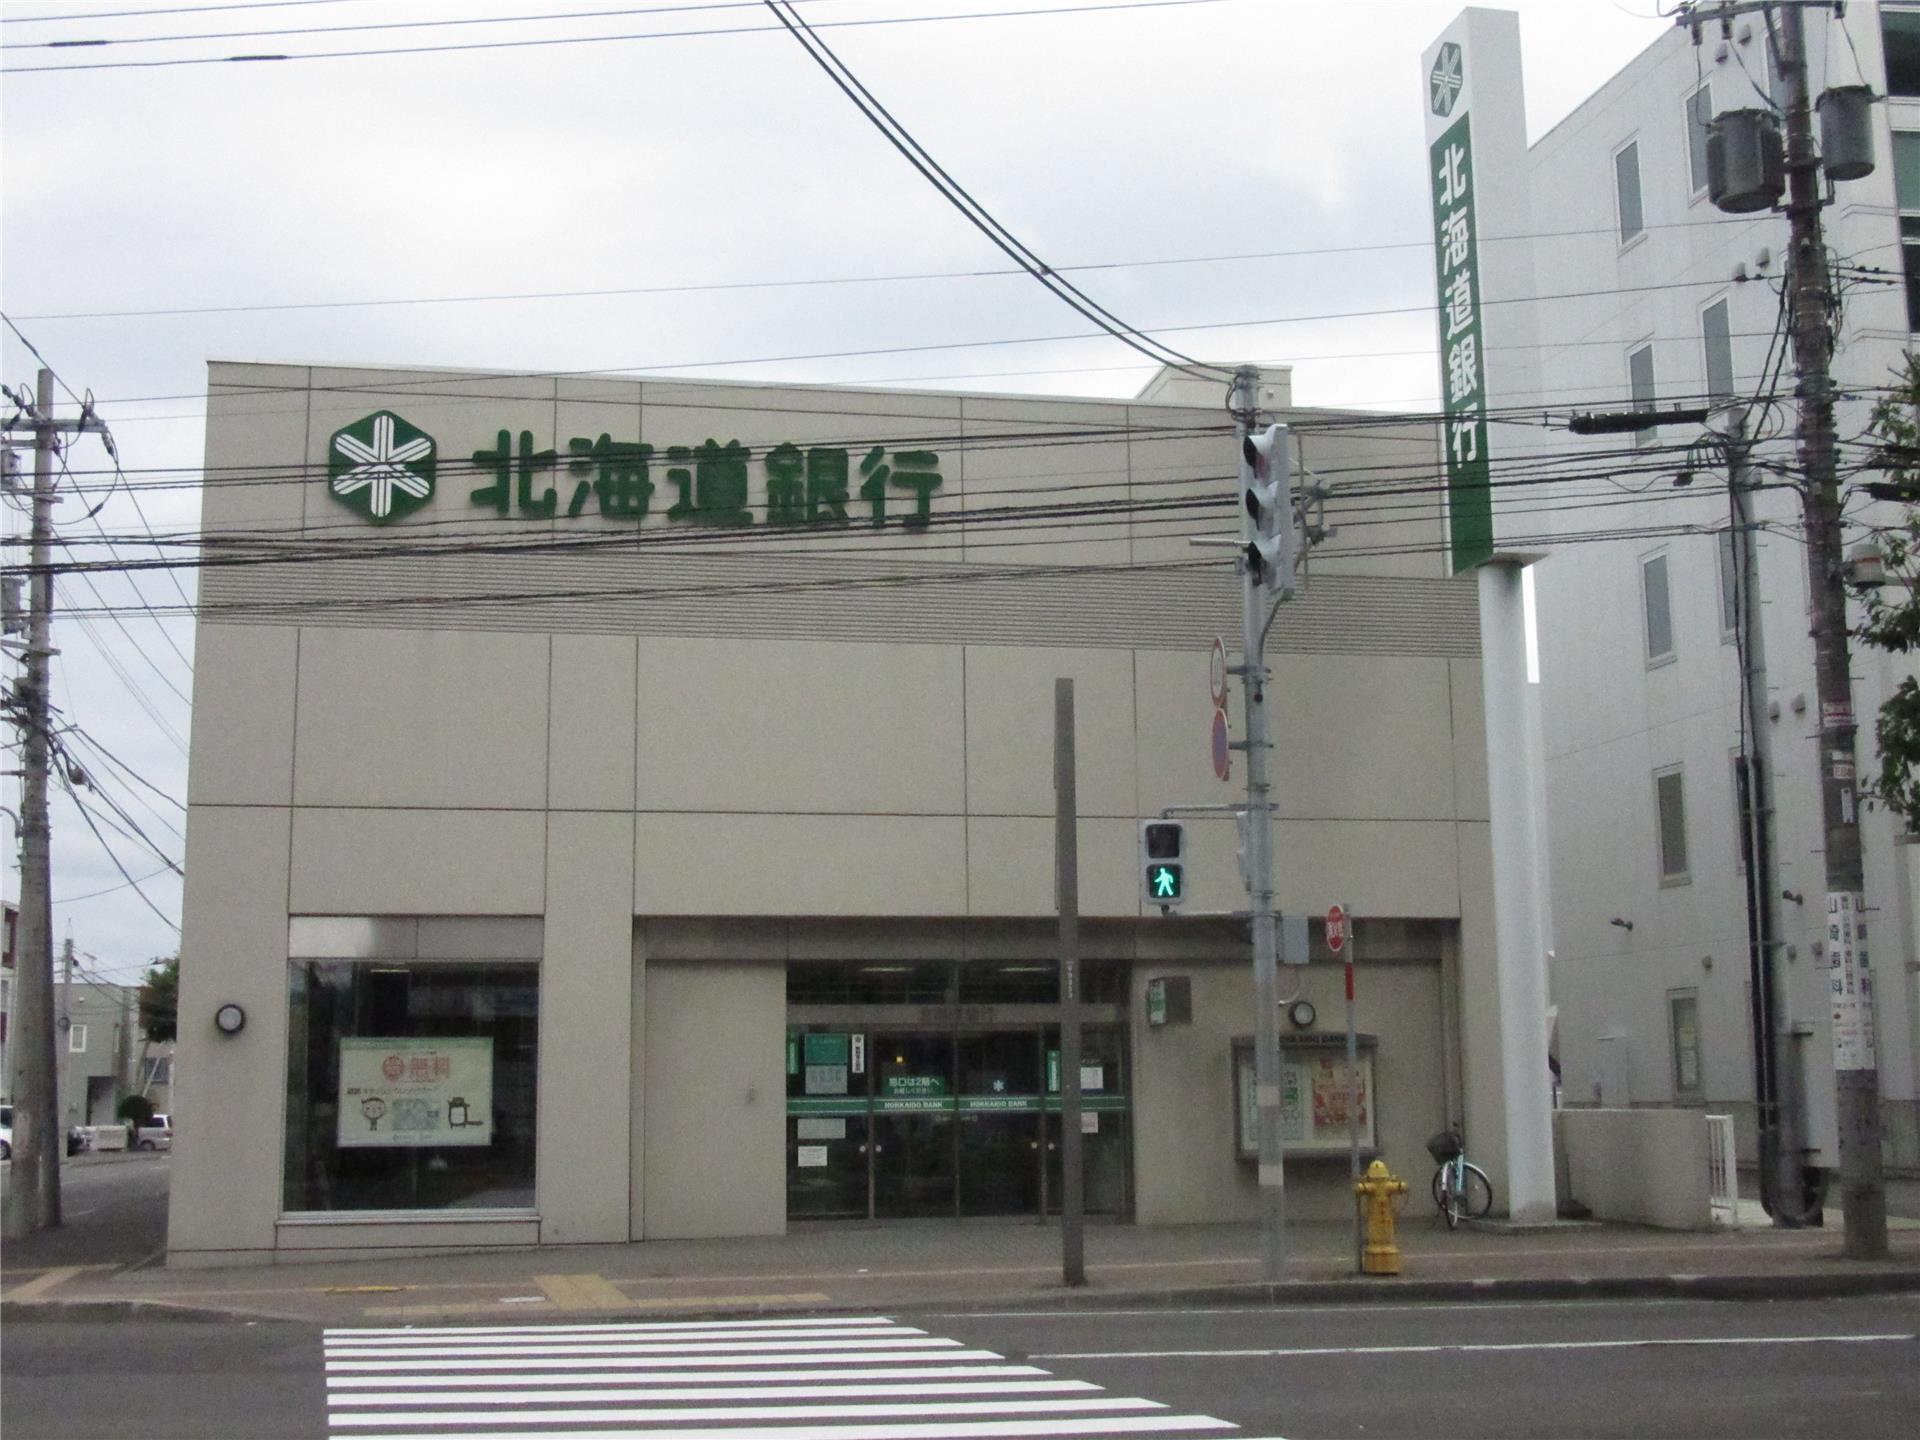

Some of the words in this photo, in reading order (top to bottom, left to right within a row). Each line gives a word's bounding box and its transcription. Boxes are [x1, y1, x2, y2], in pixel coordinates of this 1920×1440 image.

[1438, 142, 1480, 469] 北海道銀行
[470, 429, 944, 533] 北海道銀行
[884, 1101, 922, 1109] HOKKAIDO
[923, 1101, 943, 1109] BANK
[970, 1100, 1007, 1109] HOKKAIDO
[1008, 1100, 1028, 1108] BANK
